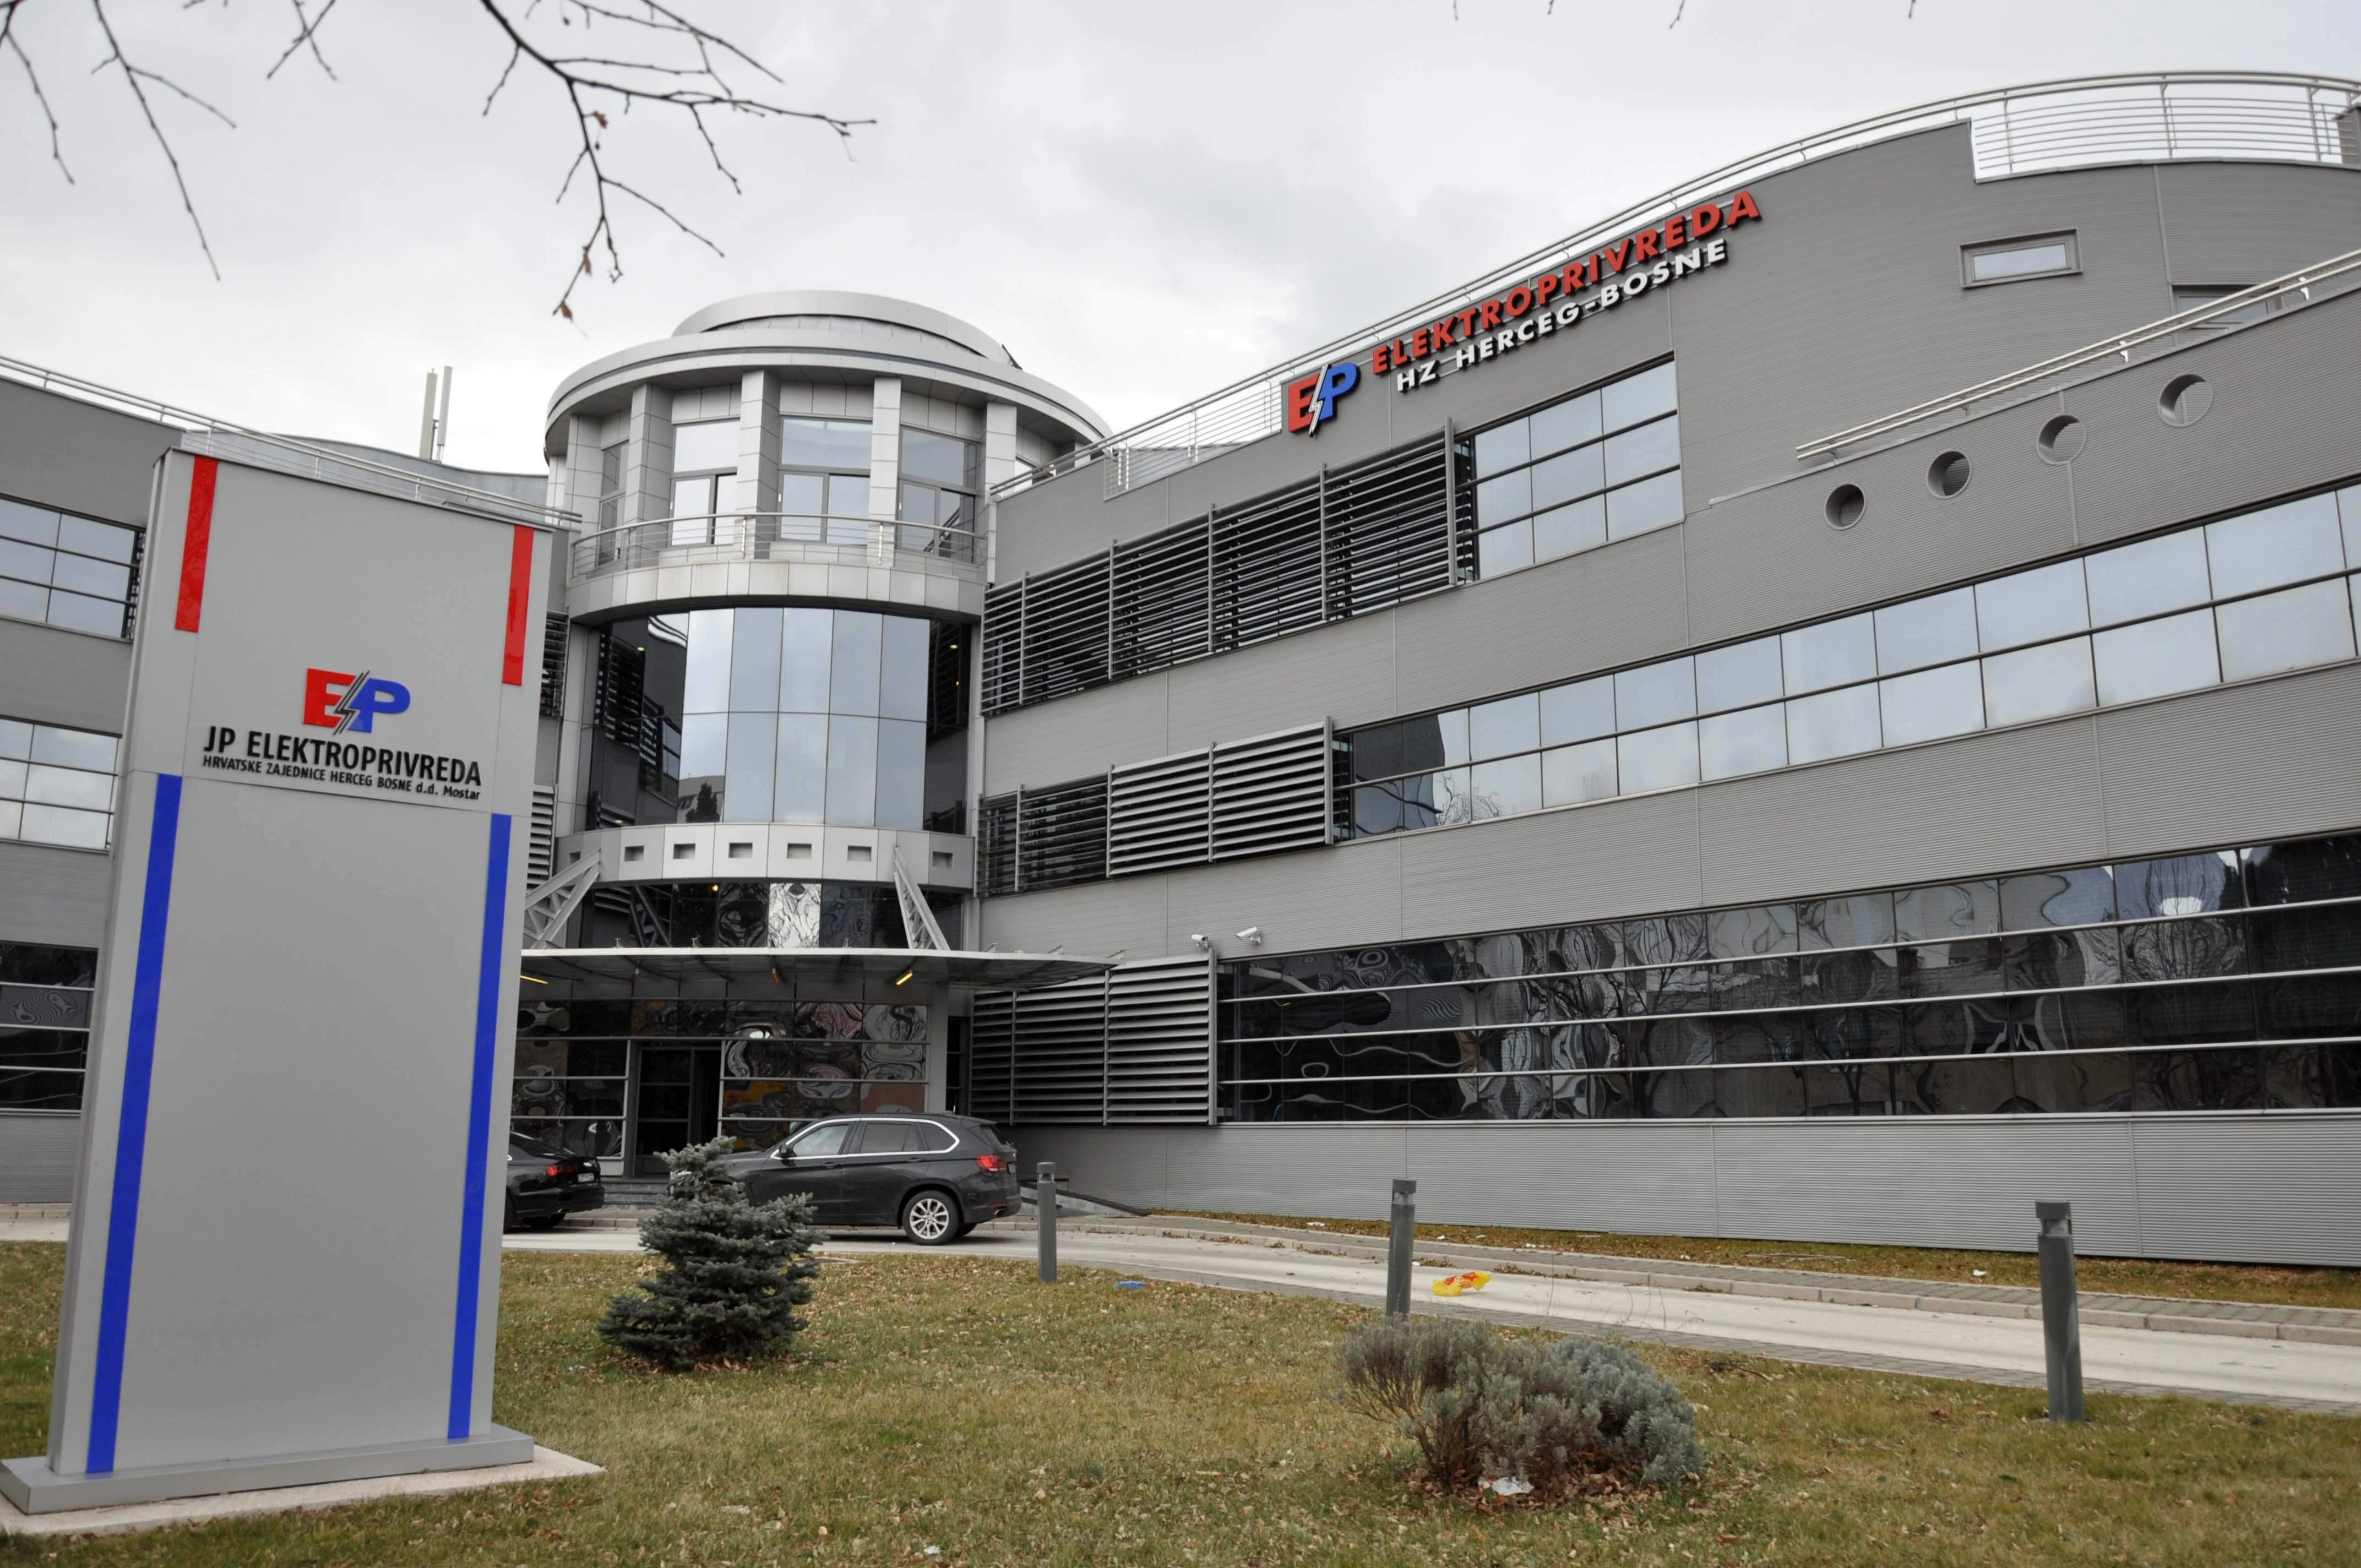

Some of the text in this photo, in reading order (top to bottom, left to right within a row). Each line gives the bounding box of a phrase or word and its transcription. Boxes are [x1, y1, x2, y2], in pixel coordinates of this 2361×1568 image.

[1372, 190, 1761, 375] ELEKTROPRIVREDA
[1397, 238, 1728, 393] HZ HERCEG-BOSNE
[1288, 361, 1360, 439] EP
[303, 668, 411, 735] EP
[203, 755, 481, 801] HRVATSKE ZAJEDNICE HERCEG BOSNE d.d. Mostar
[204, 726, 482, 786] JP ELEKTROPRIVREDA
